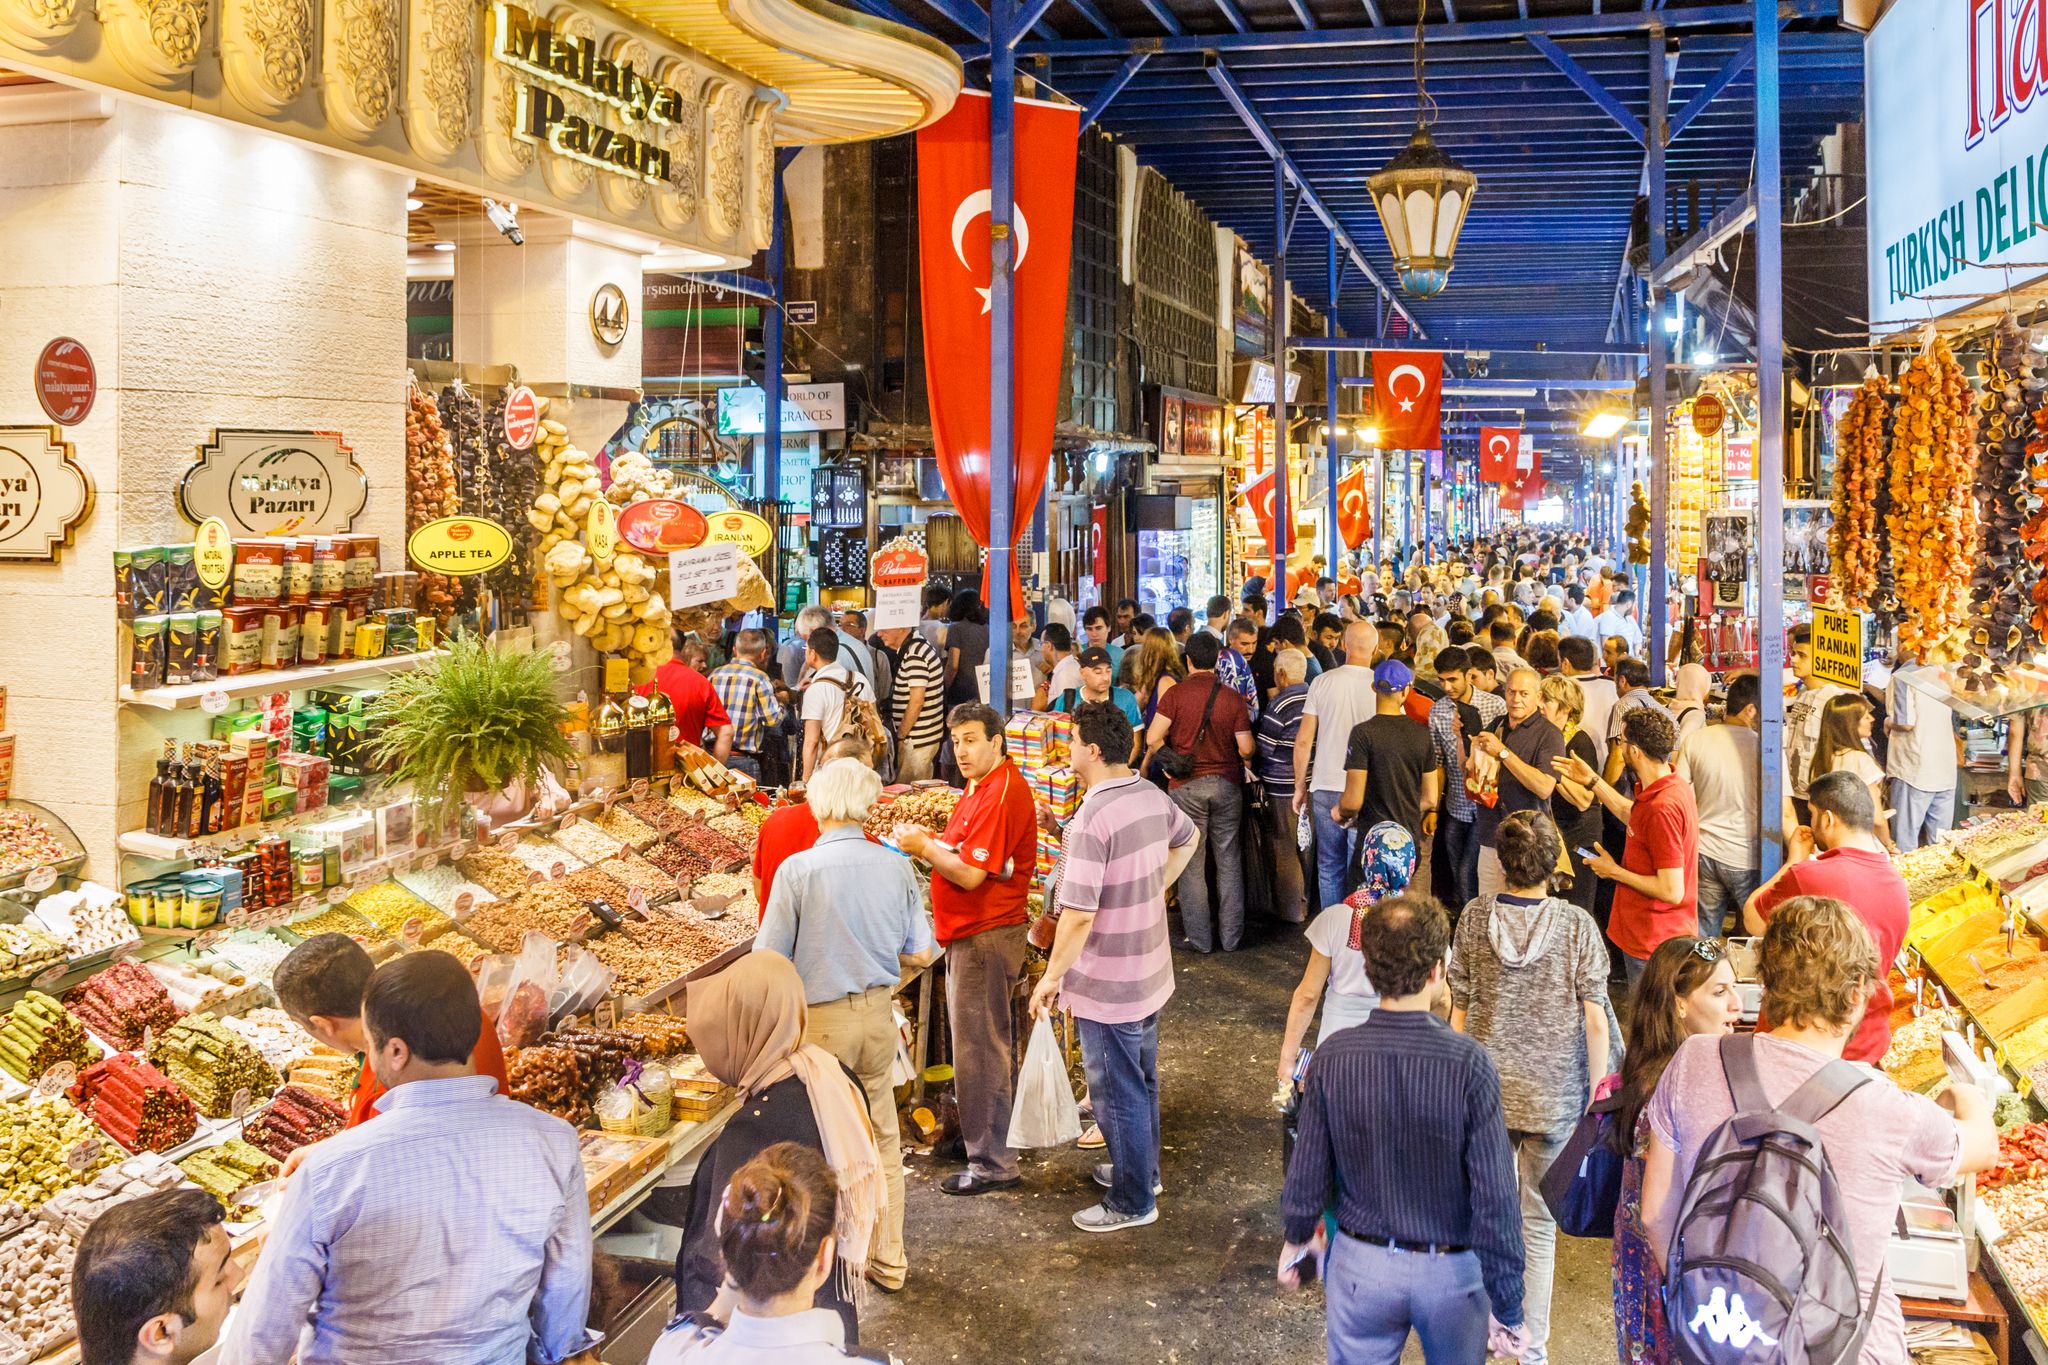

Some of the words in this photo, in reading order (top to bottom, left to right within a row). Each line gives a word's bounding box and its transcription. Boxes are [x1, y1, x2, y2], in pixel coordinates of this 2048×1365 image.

[494, 3, 683, 124] Malatya
[513, 83, 671, 183] Pazarı
[1886, 200, 1966, 305] TURKISH
[787, 391, 816, 401] ORLD
[817, 390, 831, 400] OF
[758, 408, 833, 424] FGRANCES
[241, 473, 321, 495] Malatya
[781, 475, 806, 486] HOP
[249, 496, 315, 514] Pazarı
[594, 534, 609, 548] KASA
[714, 533, 753, 542] IRANIAN
[203, 551, 223, 560] NATURAL
[429, 550, 466, 559] APPLE
[470, 549, 492, 558] TEA
[201, 564, 213, 573] FRUIT
[883, 578, 916, 586] SAFFRON
[1824, 615, 1849, 634] PURE
[1816, 635, 1857, 658] IRANIAN
[1815, 656, 1858, 682] SAFFRON
